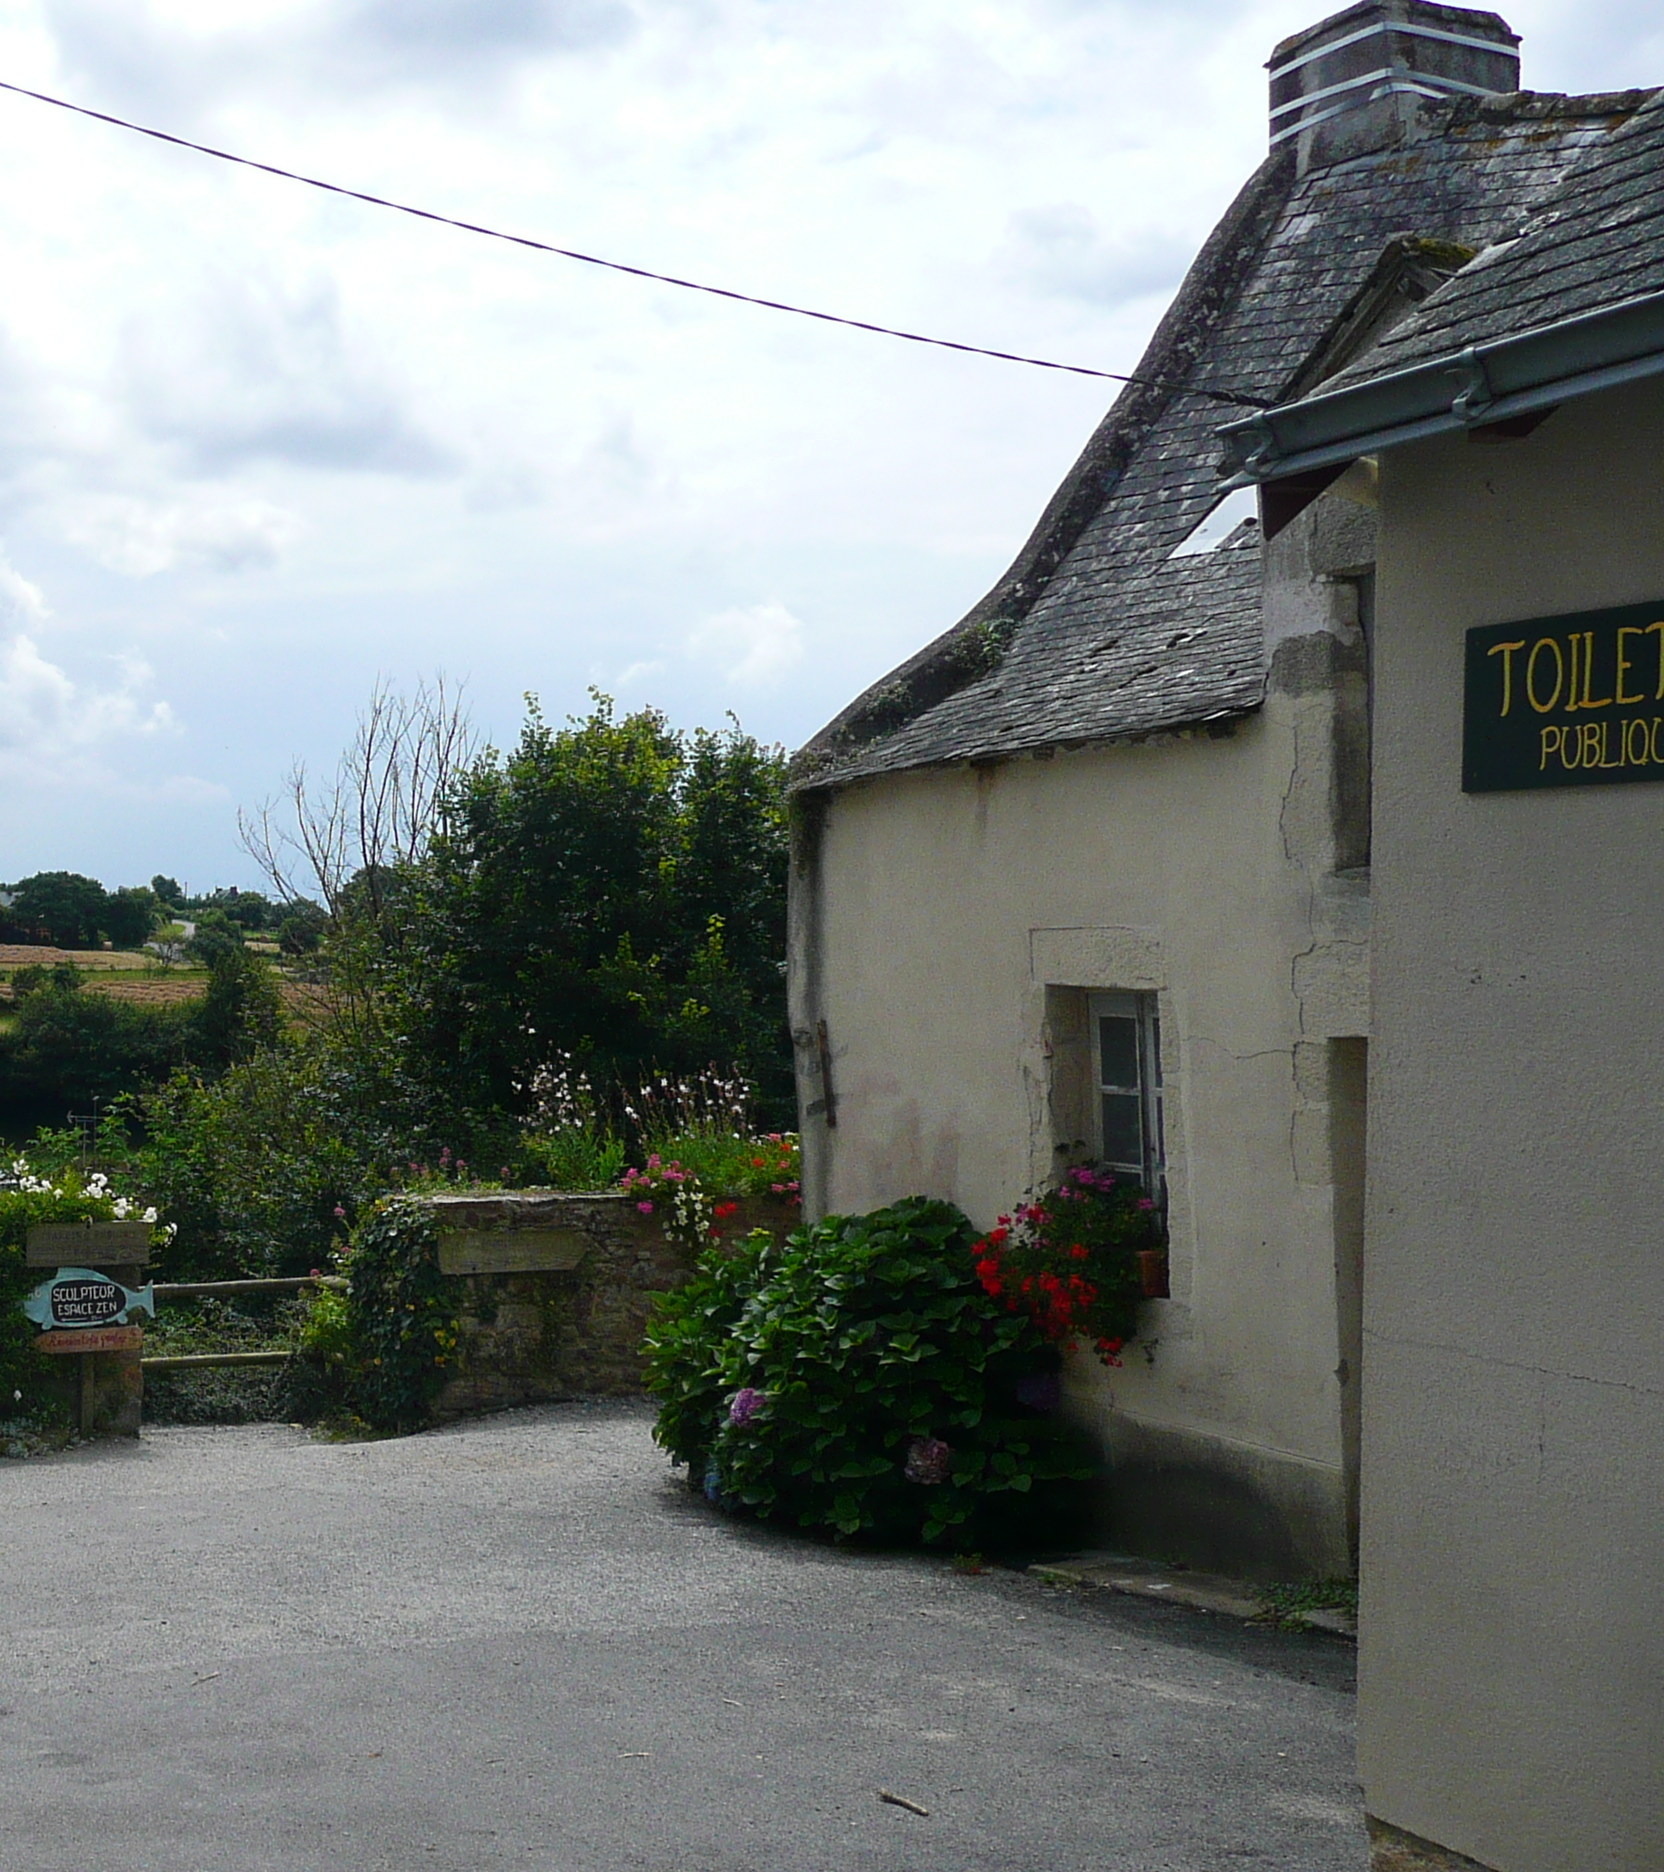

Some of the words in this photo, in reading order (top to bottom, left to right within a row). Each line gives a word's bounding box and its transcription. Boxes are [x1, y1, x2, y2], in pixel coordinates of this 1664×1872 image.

[53, 1285, 116, 1302] SCULPTEUR
[58, 1302, 94, 1316] ESPACE
[96, 1301, 118, 1312] ZEN
